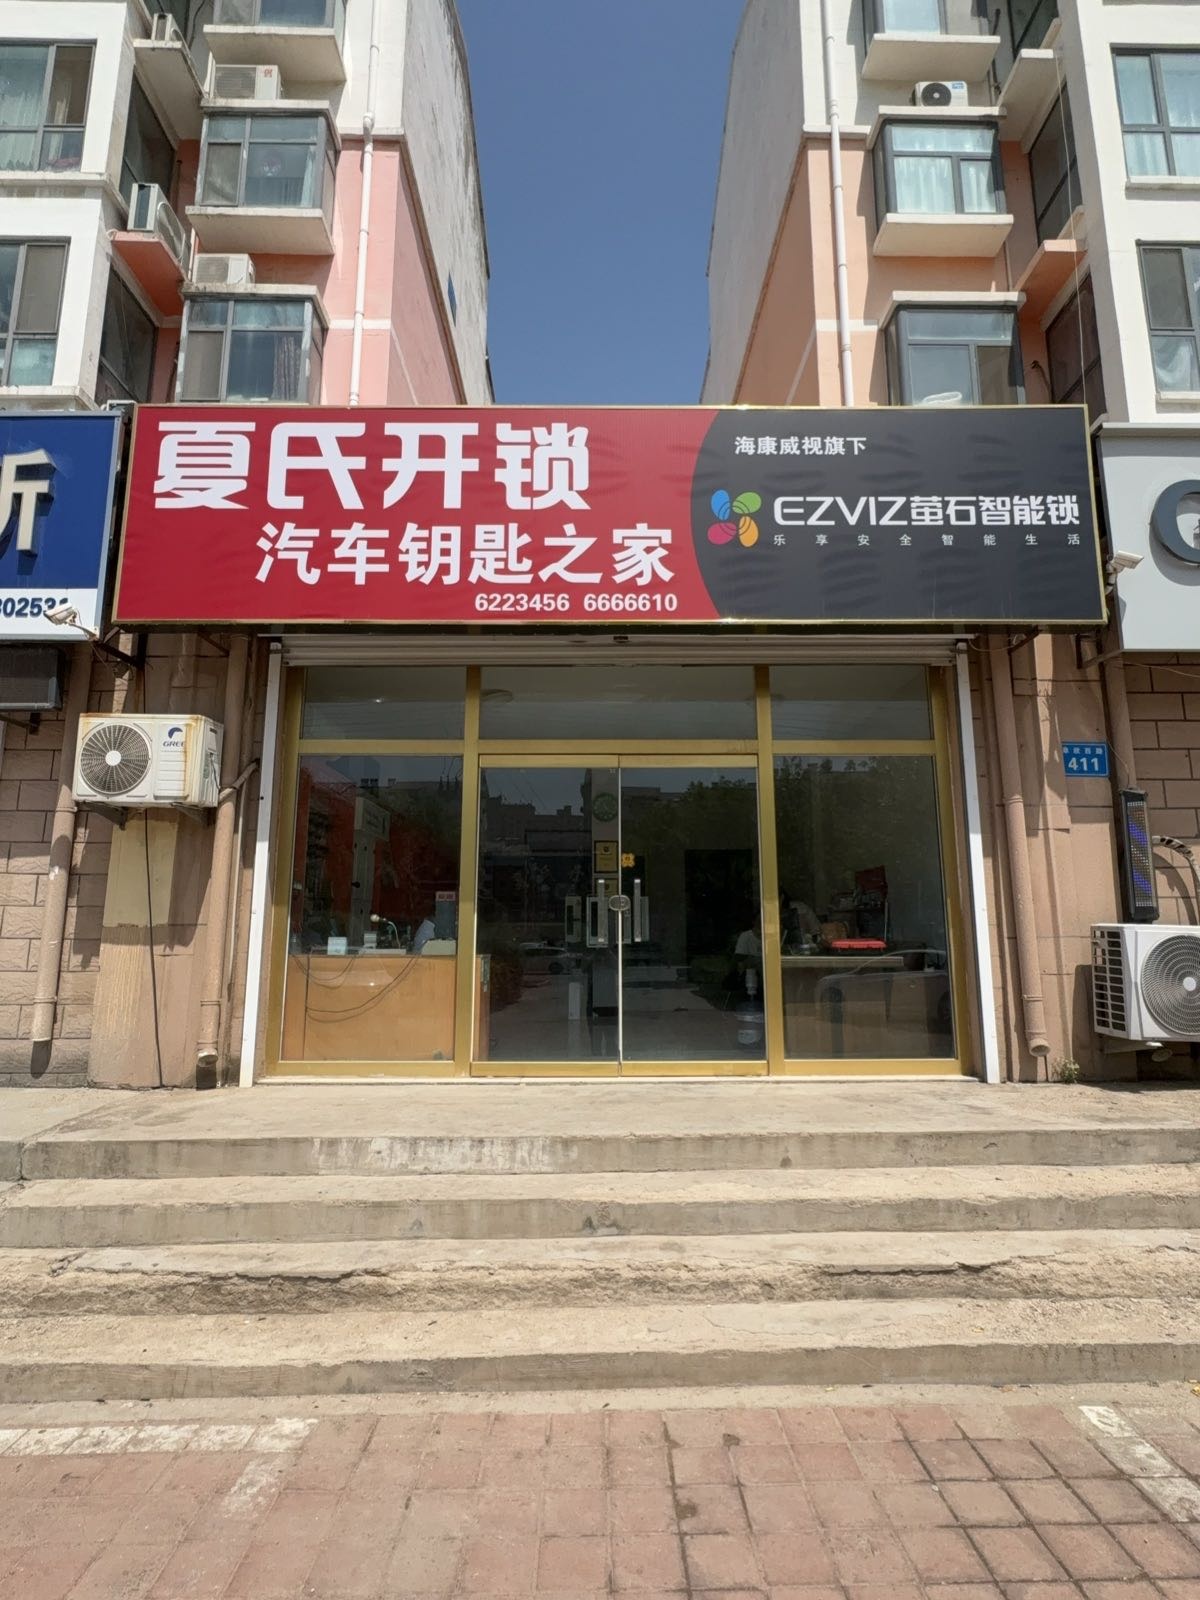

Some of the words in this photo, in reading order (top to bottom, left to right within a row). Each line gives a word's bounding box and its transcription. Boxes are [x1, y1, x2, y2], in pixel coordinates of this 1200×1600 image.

[734, 435, 867, 456] 海康威视旗下
[153, 421, 591, 510] 夏氏开锁
[255, 521, 675, 586] 汽车钥匙之家
[475, 593, 570, 612] 6223456
[583, 593, 678, 612] 6666610
[1068, 757, 1099, 771] 411
